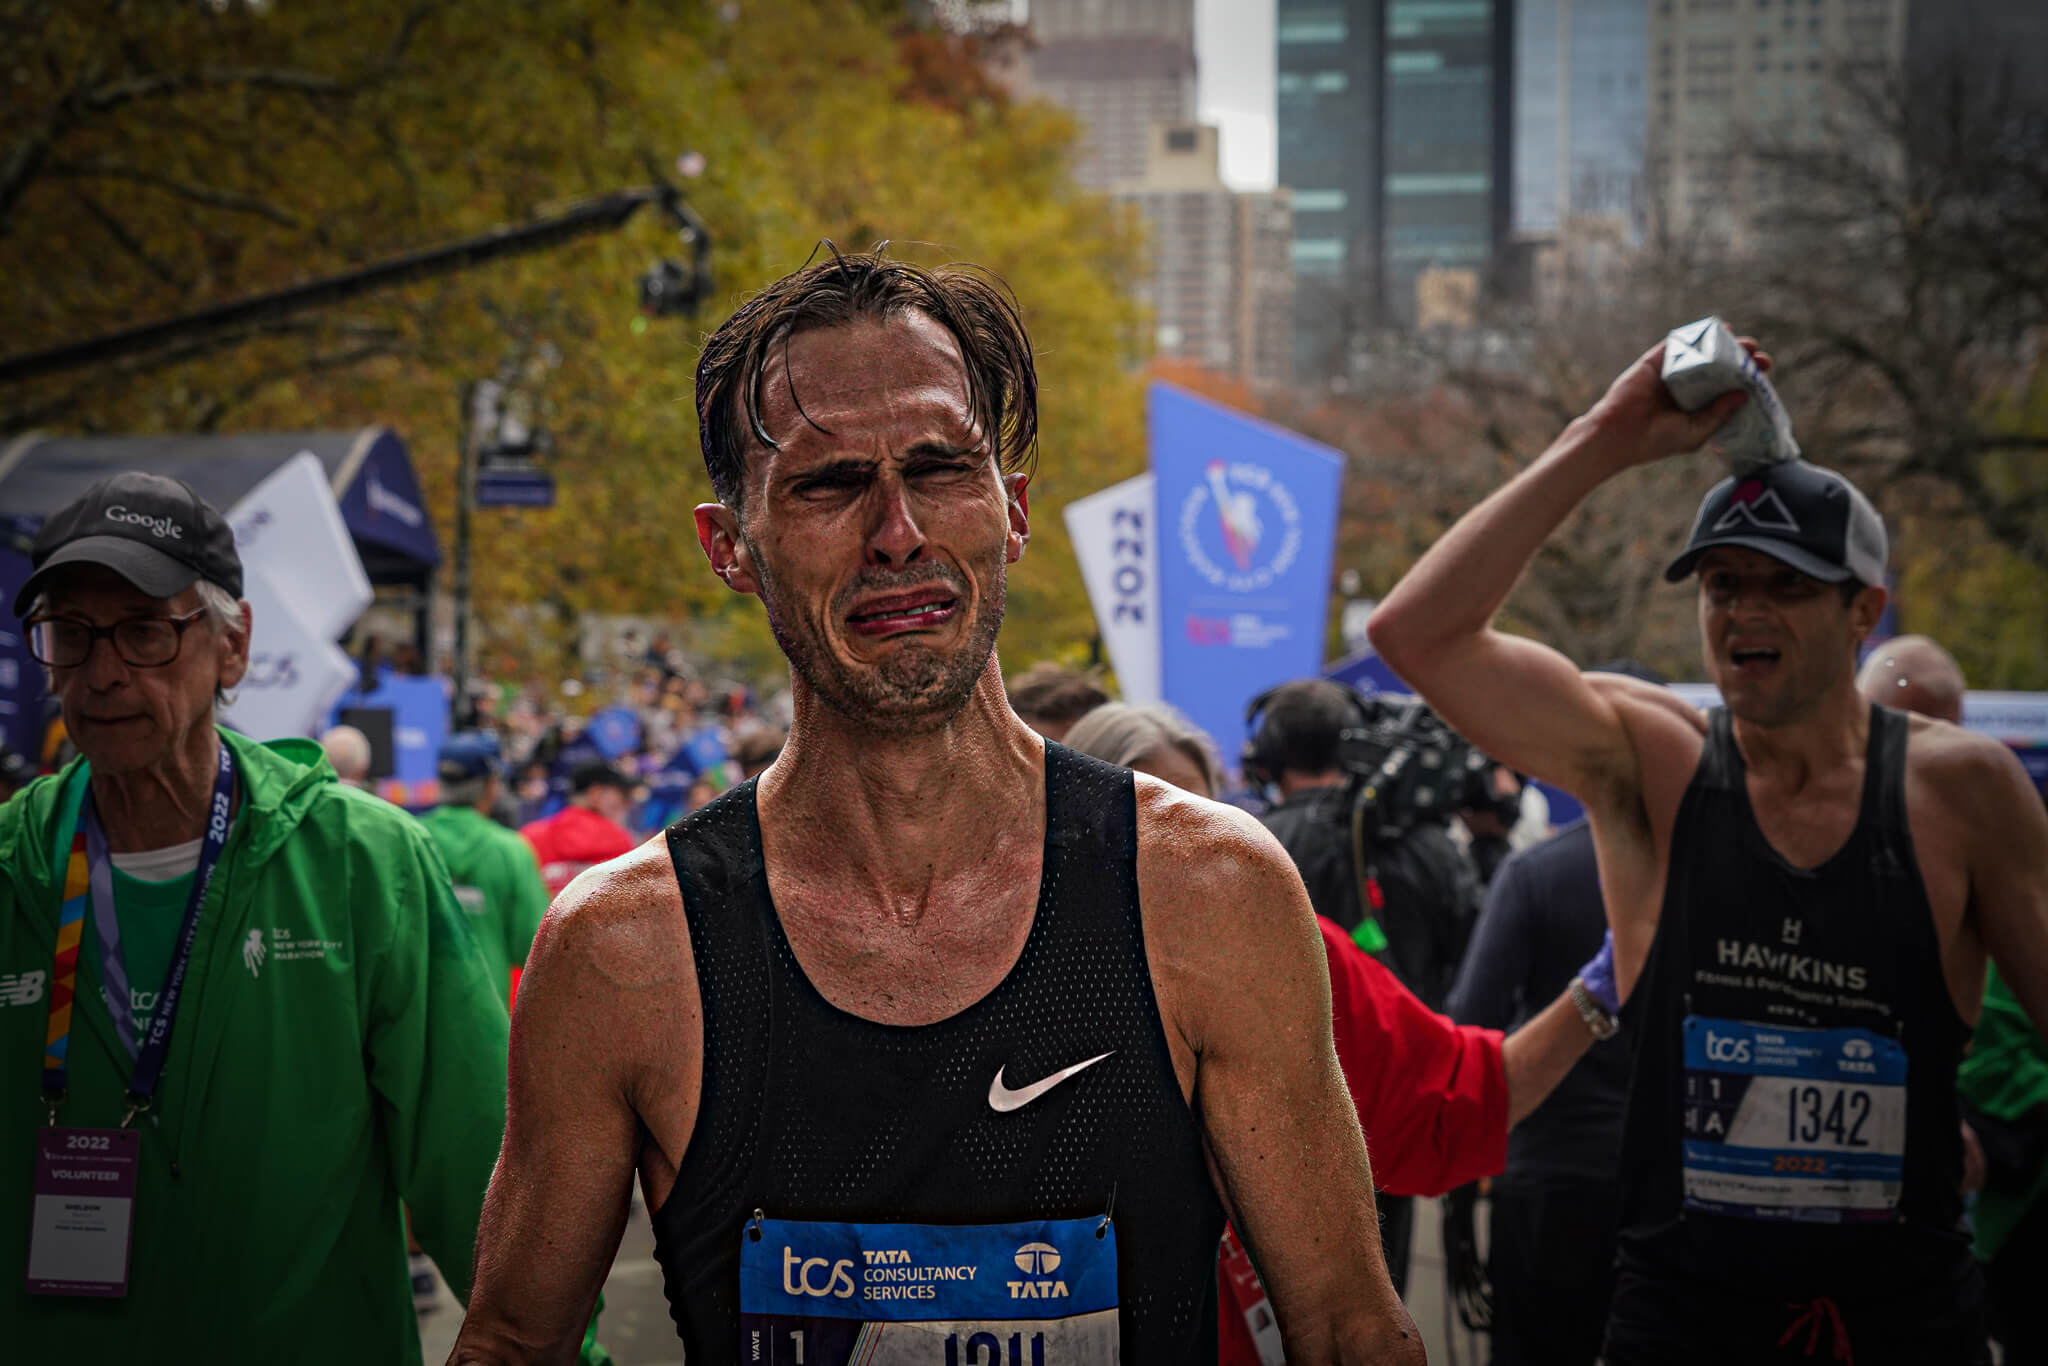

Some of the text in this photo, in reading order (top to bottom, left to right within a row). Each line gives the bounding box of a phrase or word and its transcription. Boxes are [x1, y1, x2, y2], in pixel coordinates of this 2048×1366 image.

[105, 504, 183, 539] Google
[1113, 509, 1145, 622] 2022
[148, 1017, 167, 1046] TCS
[208, 791, 231, 845] 2022
[1716, 937, 1869, 992] HAWKINS
[1705, 1029, 1753, 1064] tcs
[1836, 1060, 1878, 1074] TATA
[1708, 1077, 1721, 1100] 1
[1704, 1110, 1725, 1134] A
[1788, 1087, 1871, 1146] 1342
[66, 1135, 111, 1150] 2022
[51, 1169, 120, 1182] VOLUNTEER
[1771, 1155, 1827, 1174] 2022
[862, 1250, 912, 1264] TATA
[783, 1245, 855, 1300] tcs
[863, 1265, 977, 1284] CONSULTANCY
[863, 1285, 936, 1301] SERVICES
[1006, 1280, 1070, 1300] TATA
[752, 1329, 761, 1361] WAVE
[789, 1329, 805, 1366] 1
